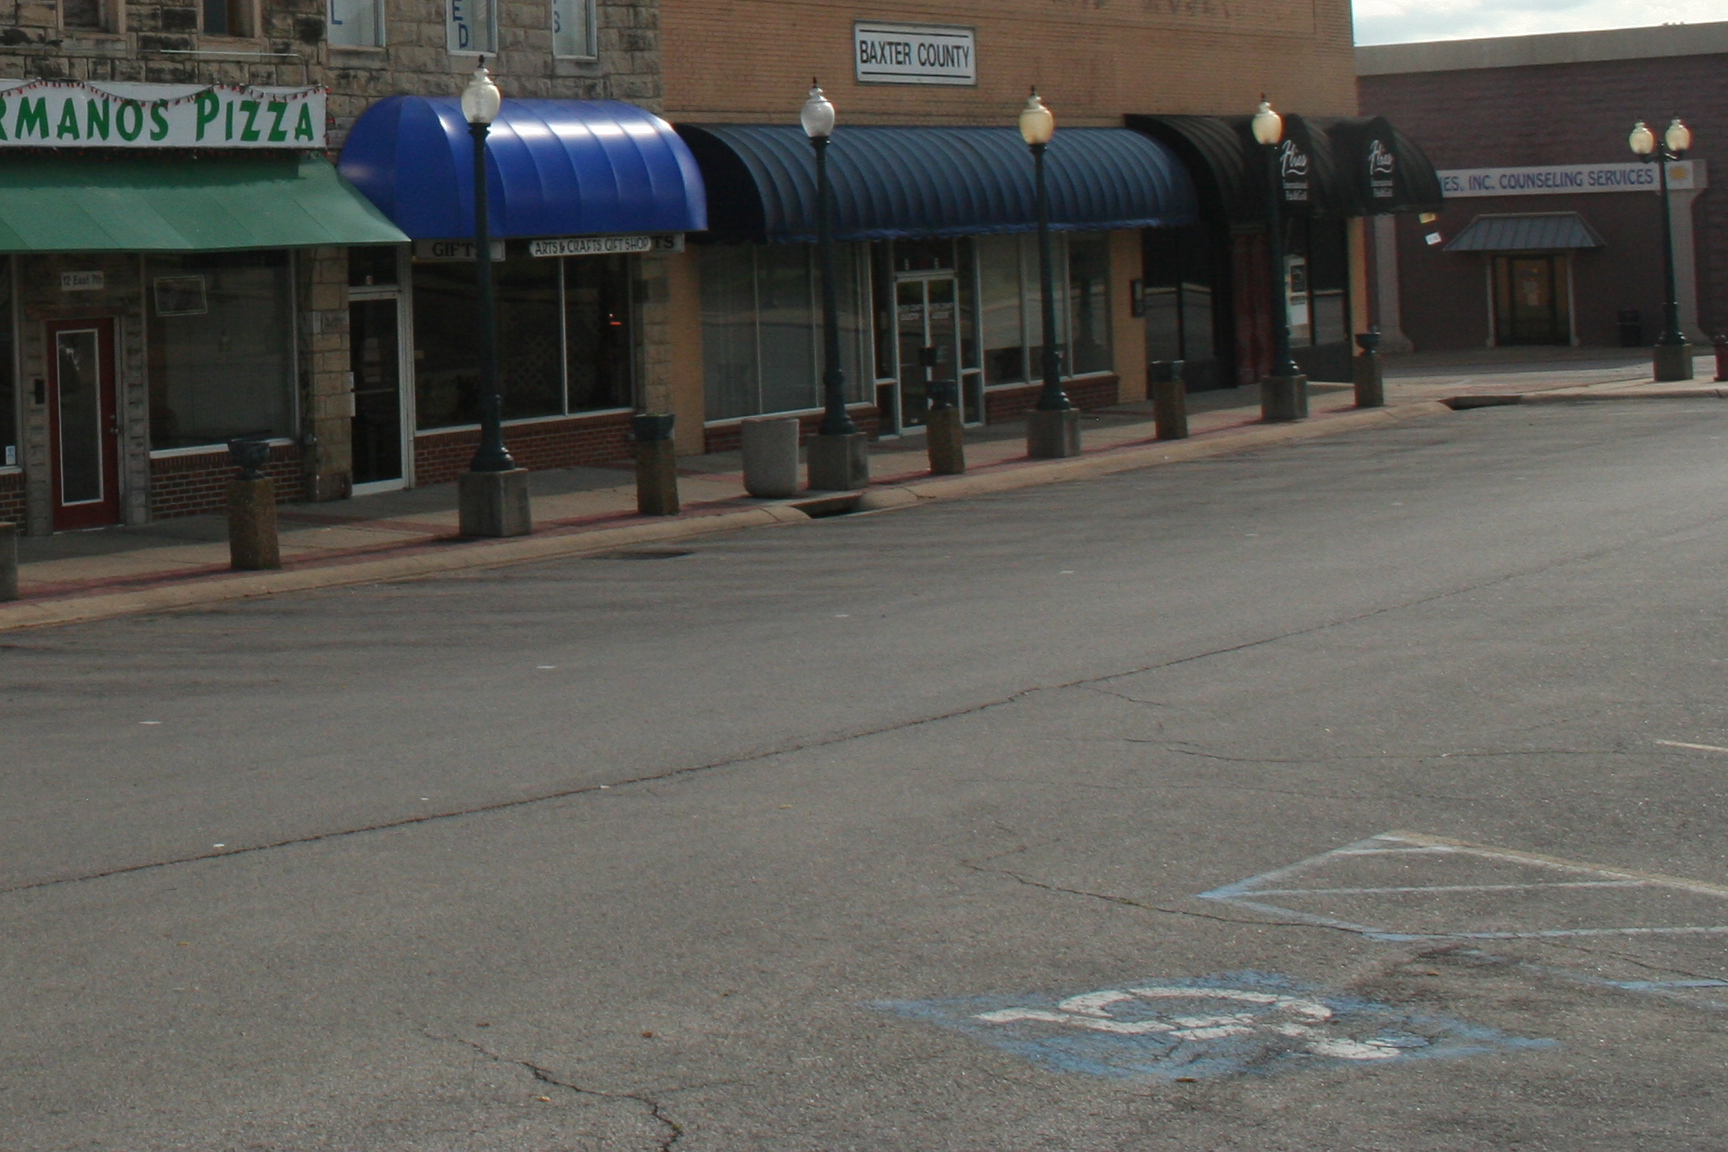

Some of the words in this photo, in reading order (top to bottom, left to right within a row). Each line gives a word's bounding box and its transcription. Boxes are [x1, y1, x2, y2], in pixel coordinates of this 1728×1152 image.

[859, 39, 912, 66] BAXTER
[917, 42, 970, 68] COUNTY
[195, 89, 314, 142] PIZZA
[1499, 170, 1583, 190] COUNSELING
[1588, 168, 1653, 186] SERVICES
